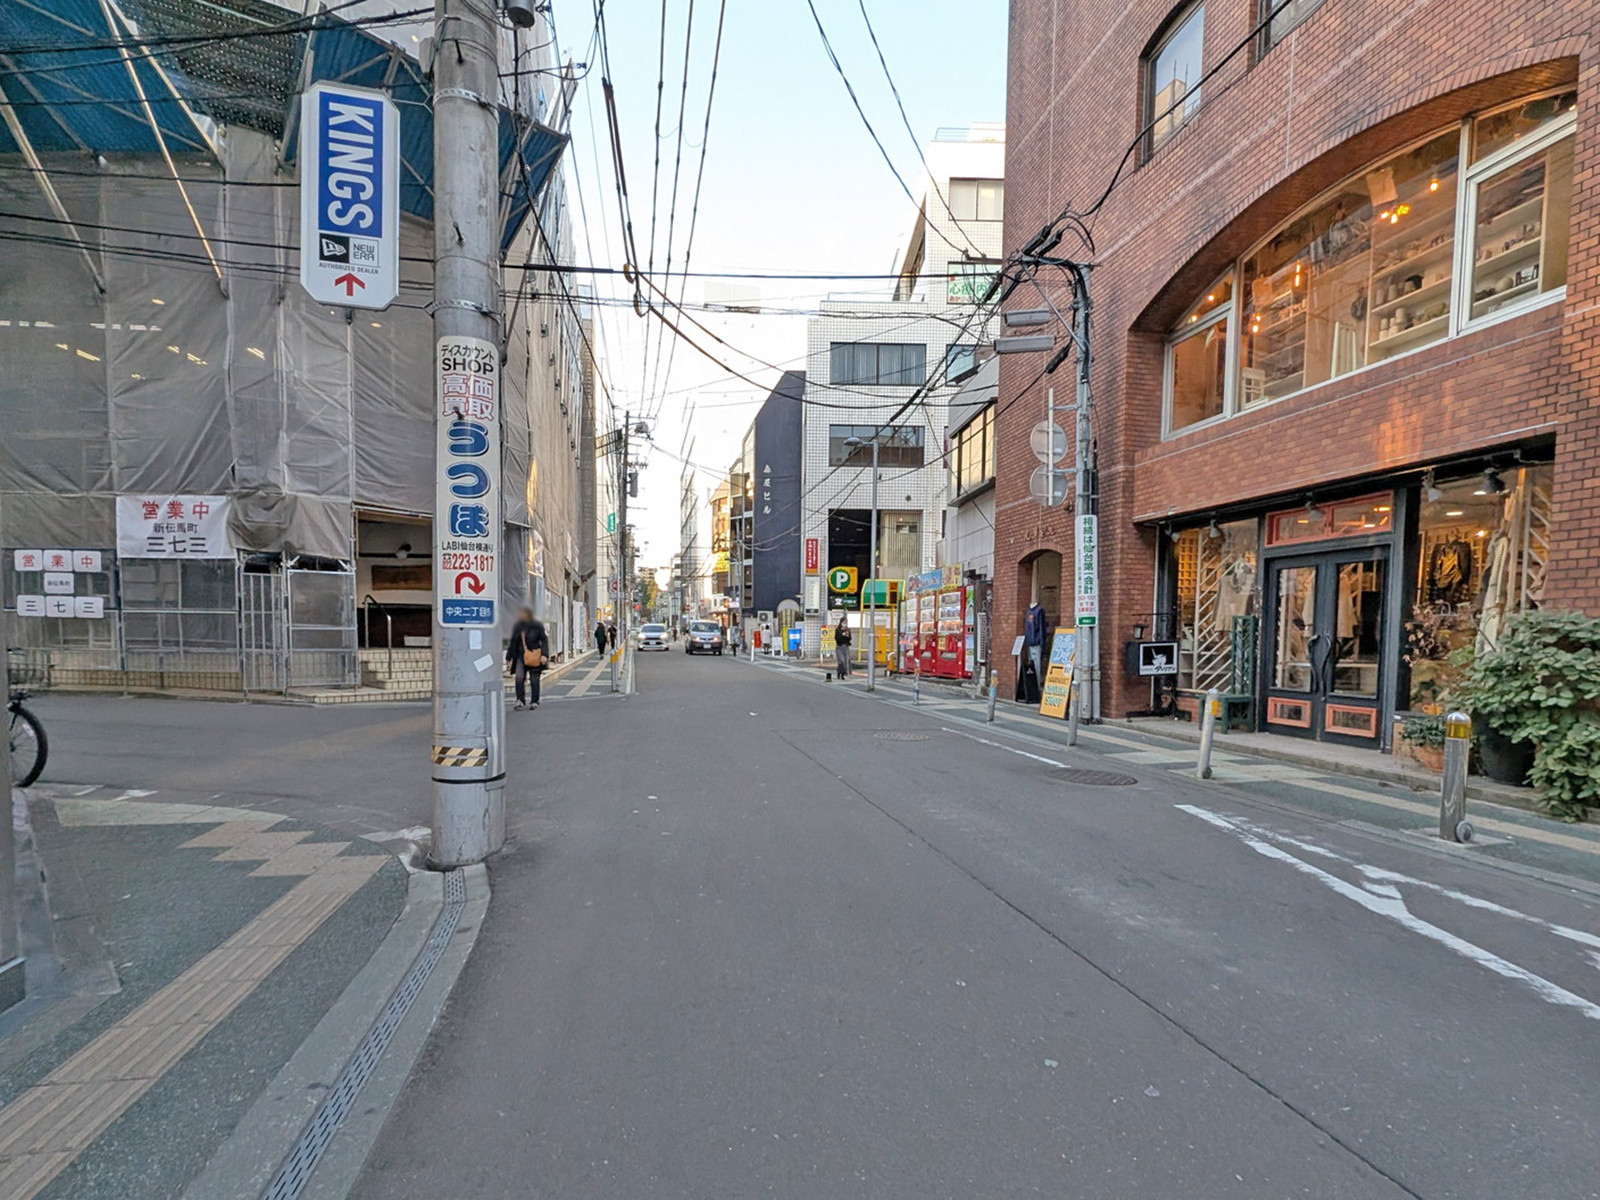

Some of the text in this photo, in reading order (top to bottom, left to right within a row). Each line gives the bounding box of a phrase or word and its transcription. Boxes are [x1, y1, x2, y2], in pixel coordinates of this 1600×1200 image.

[327, 102, 374, 229] KINGS
[353, 243, 375, 254] NEW
[353, 252, 375, 262] ERA
[319, 262, 379, 275] AUTHORIZED DEALER
[441, 344, 495, 362] ディスカウント
[442, 358, 494, 375] SHOP
[442, 373, 494, 400] 高価
[442, 395, 495, 421] 買取
[446, 420, 490, 537] うつぼ
[141, 501, 210, 520] 営業中
[152, 523, 198, 534] 新伝馬町
[146, 537, 208, 554] 三七三
[22, 554, 93, 568] 営業中
[452, 553, 495, 571] 223-1817
[836, 572, 848, 588] P
[25, 600, 95, 614] 三七三
